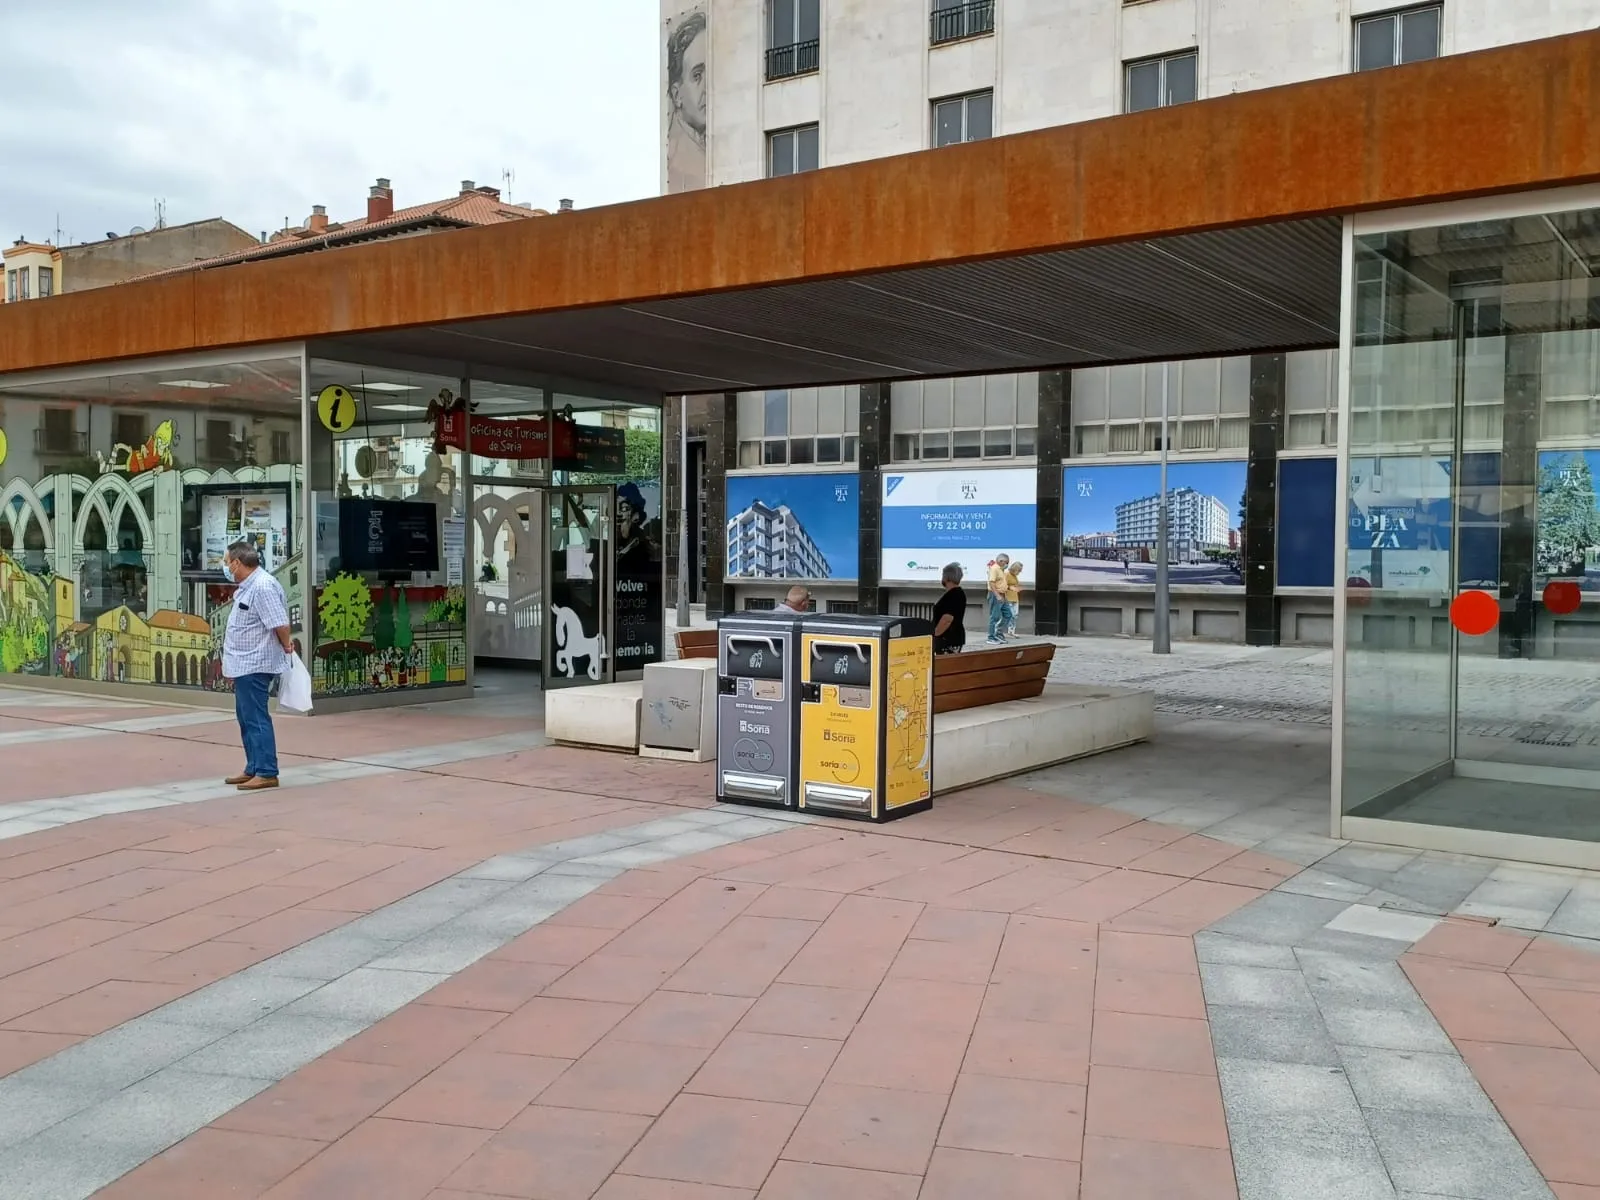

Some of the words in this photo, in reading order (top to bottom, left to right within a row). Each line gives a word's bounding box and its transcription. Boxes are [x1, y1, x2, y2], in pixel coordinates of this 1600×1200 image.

[503, 427, 513, 438] de
[488, 440, 499, 451] de
[500, 440, 522, 453] Soria
[920, 512, 963, 520] INFORMACIÓN
[927, 521, 944, 530] 975
[946, 521, 958, 530] 22
[960, 521, 972, 530] 04
[975, 521, 987, 530] 00
[1371, 531, 1401, 548] ZA
[747, 723, 770, 735] Soria
[831, 731, 856, 744] Soria
